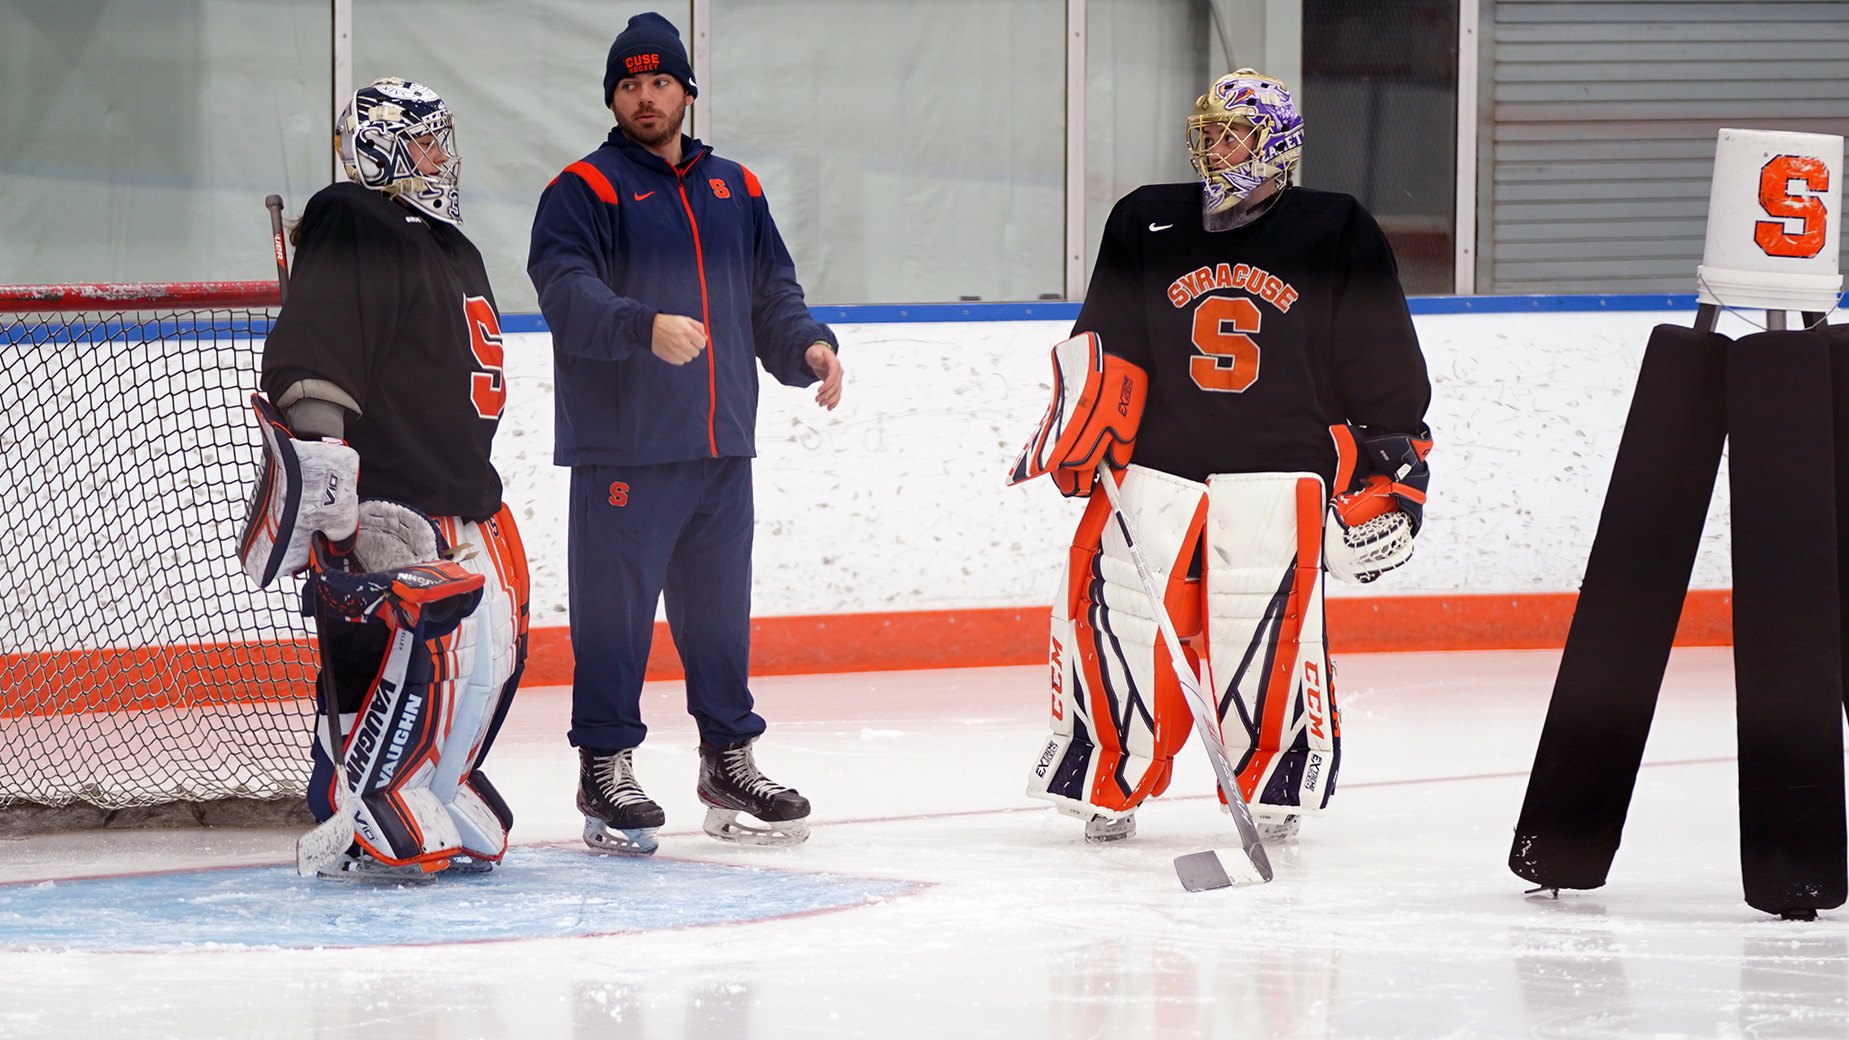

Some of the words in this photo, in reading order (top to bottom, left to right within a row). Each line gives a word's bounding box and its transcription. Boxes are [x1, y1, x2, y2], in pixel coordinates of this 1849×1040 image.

[628, 63, 658, 74] HOCKEY
[709, 178, 731, 199] S
[1754, 154, 1830, 259] S
[1167, 263, 1299, 314] SYRACUSE
[1189, 295, 1262, 393] S
[608, 481, 630, 507] S
[1051, 636, 1063, 722] CCM
[1304, 660, 1325, 740] CCM
[346, 677, 397, 794] VAUGHN
[375, 694, 422, 789] VAUGHN
